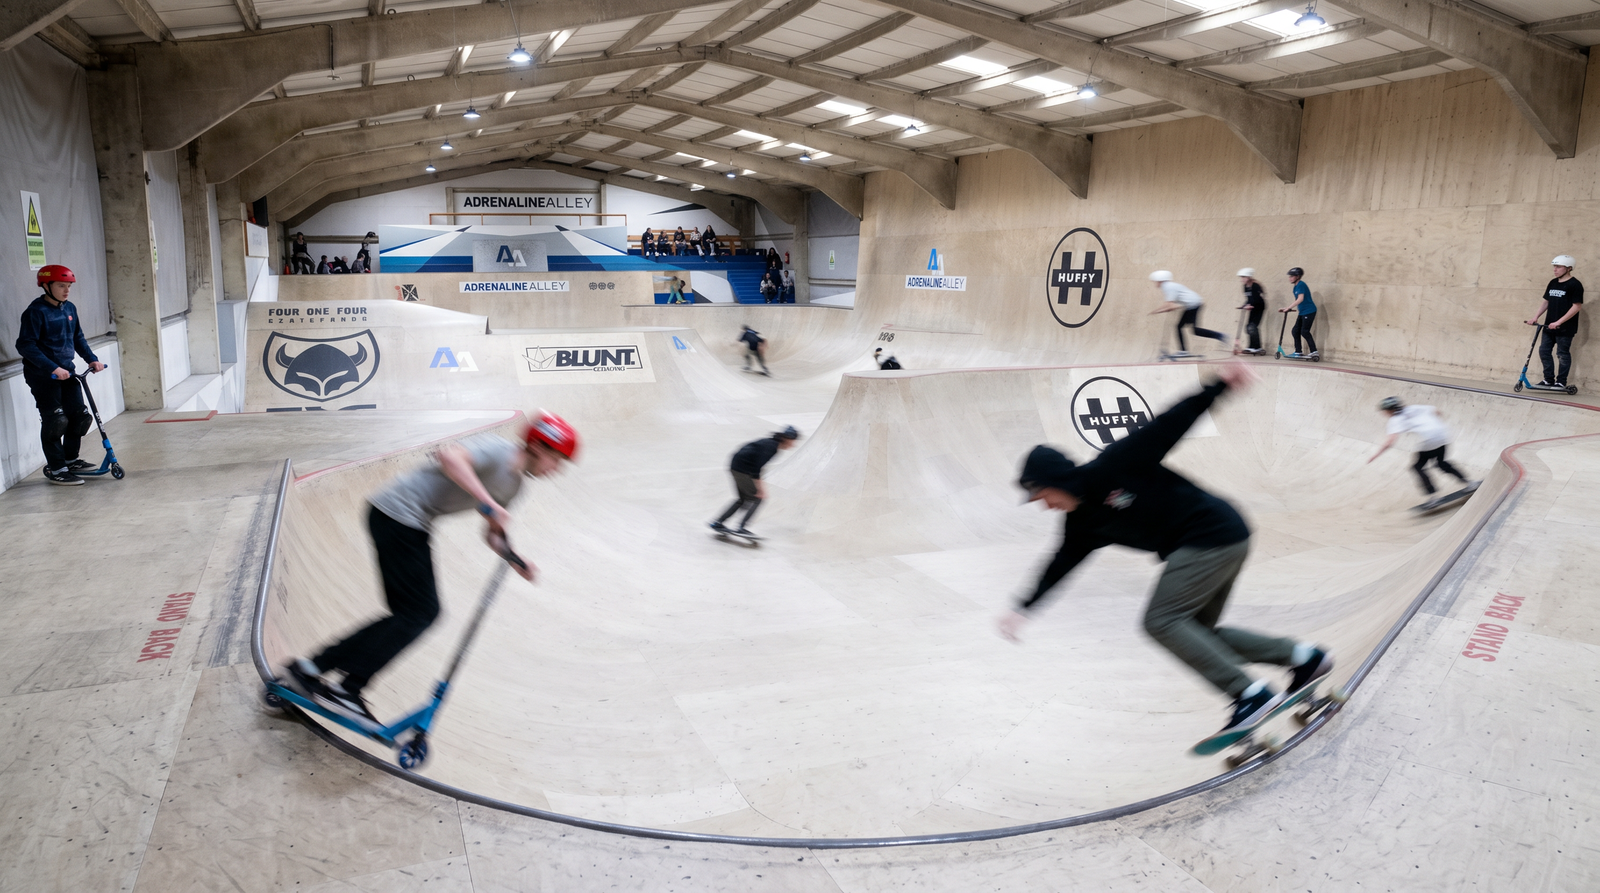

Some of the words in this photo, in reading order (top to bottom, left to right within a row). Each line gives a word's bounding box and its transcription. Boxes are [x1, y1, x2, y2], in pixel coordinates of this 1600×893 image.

[1058, 272, 1096, 284] HUFFY
[268, 308, 300, 317] FOUR
[306, 307, 330, 316] ONE
[337, 306, 368, 315] FOUR
[1089, 414, 1139, 426] HUFFY
[156, 591, 196, 622] STAND
[1484, 591, 1526, 621] BACK
[136, 627, 182, 663] BACK
[1461, 622, 1509, 662] STAND
